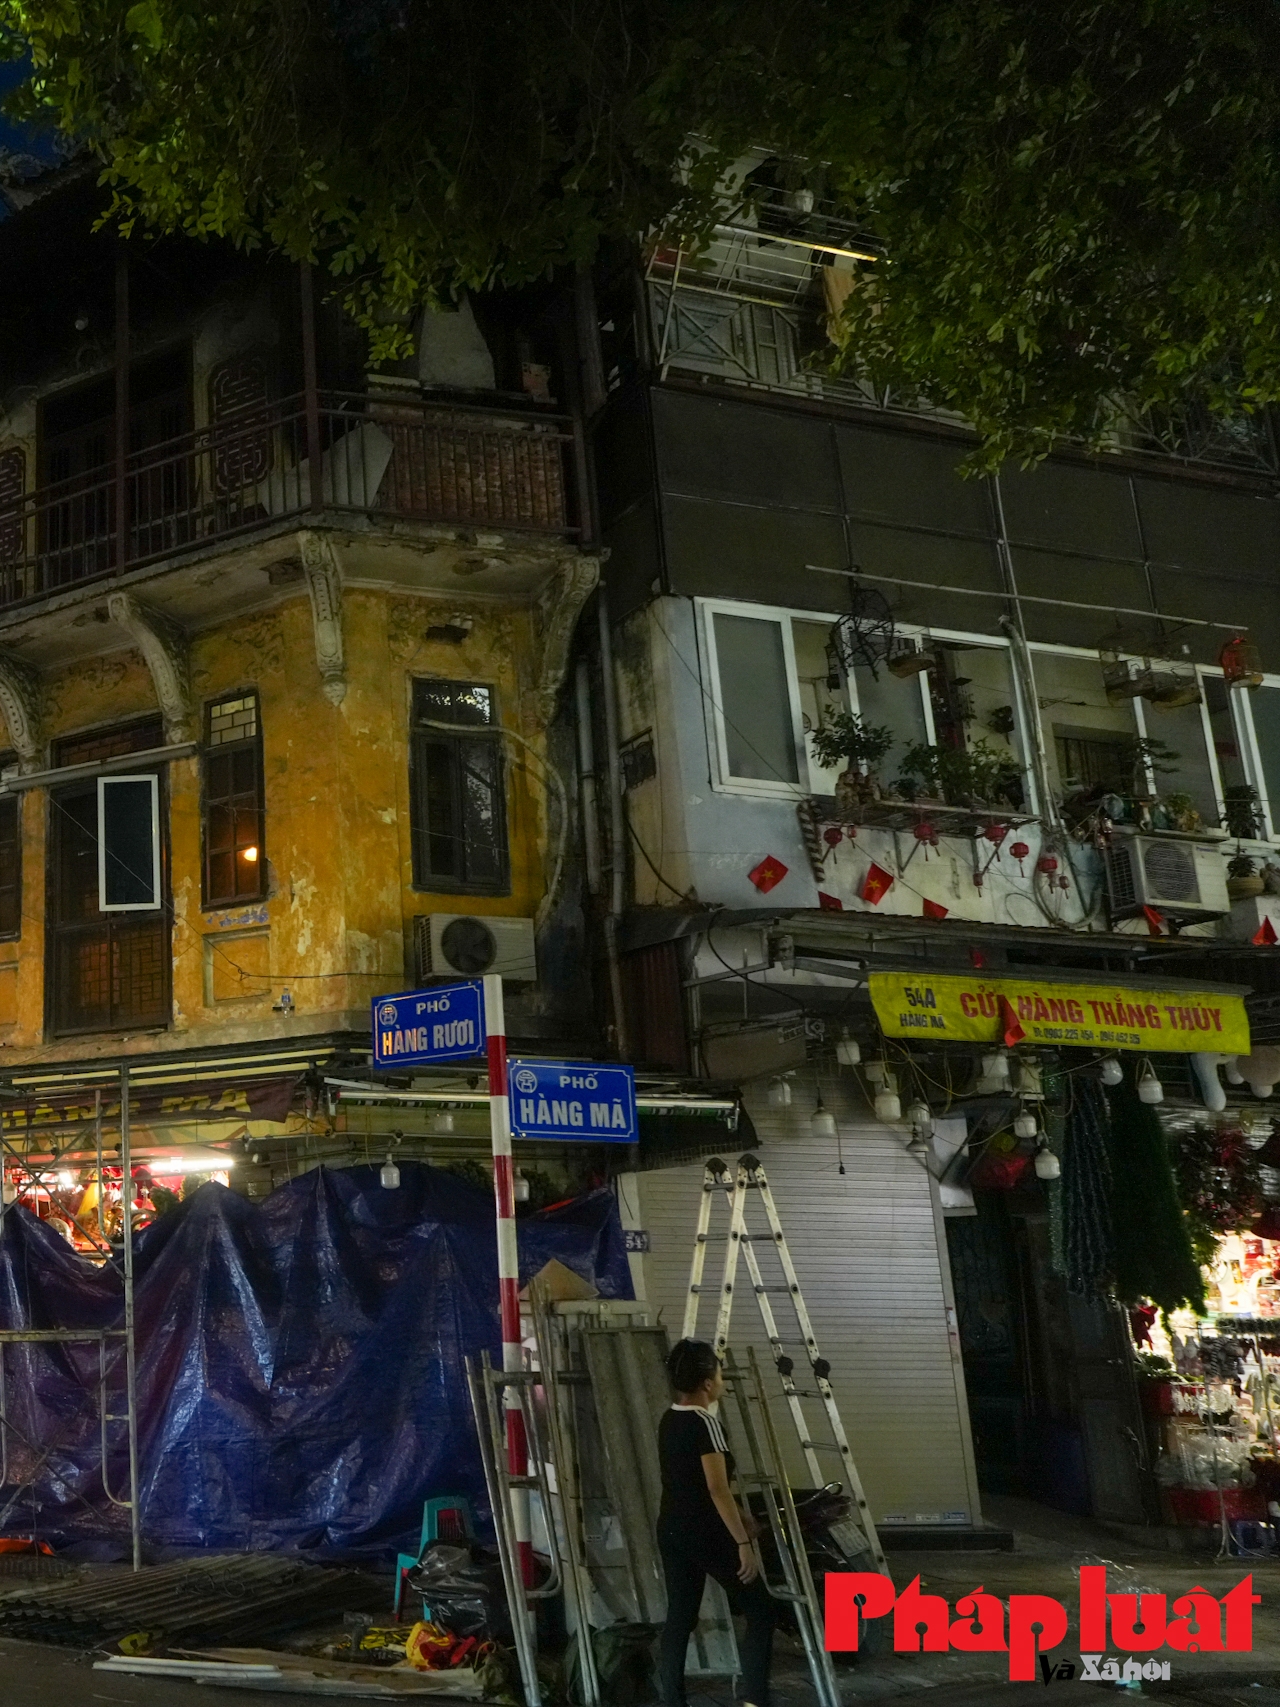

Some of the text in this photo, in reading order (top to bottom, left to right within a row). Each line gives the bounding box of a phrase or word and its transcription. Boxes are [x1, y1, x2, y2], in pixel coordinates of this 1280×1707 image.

[416, 992, 451, 1015] PHỐ
[904, 987, 936, 1009] 54A
[899, 1010, 946, 1029] HÀNG MÃ
[1017, 992, 1084, 1023] HÀNG
[1087, 994, 1162, 1029] THẮNG
[1164, 1003, 1223, 1032] THÚY
[382, 1019, 474, 1056] HÀNG RƯƠI
[560, 1072, 598, 1090] PHỐ
[520, 1093, 626, 1129] HÀNG MÃ
